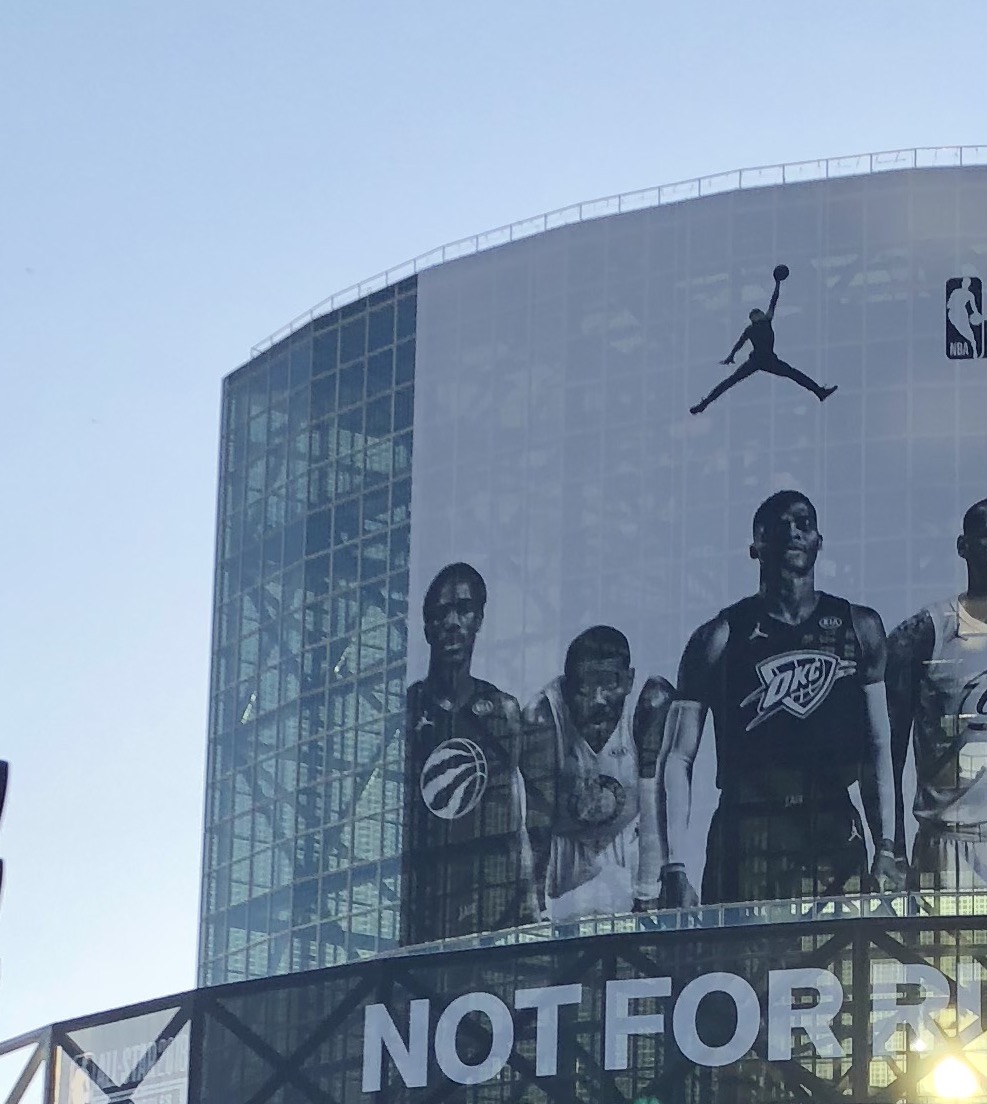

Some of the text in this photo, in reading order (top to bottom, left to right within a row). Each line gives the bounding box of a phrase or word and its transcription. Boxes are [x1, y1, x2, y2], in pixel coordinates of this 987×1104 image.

[949, 341, 970, 356] NBA
[361, 983, 582, 1093] NOT
[603, 967, 845, 1072] FOR
